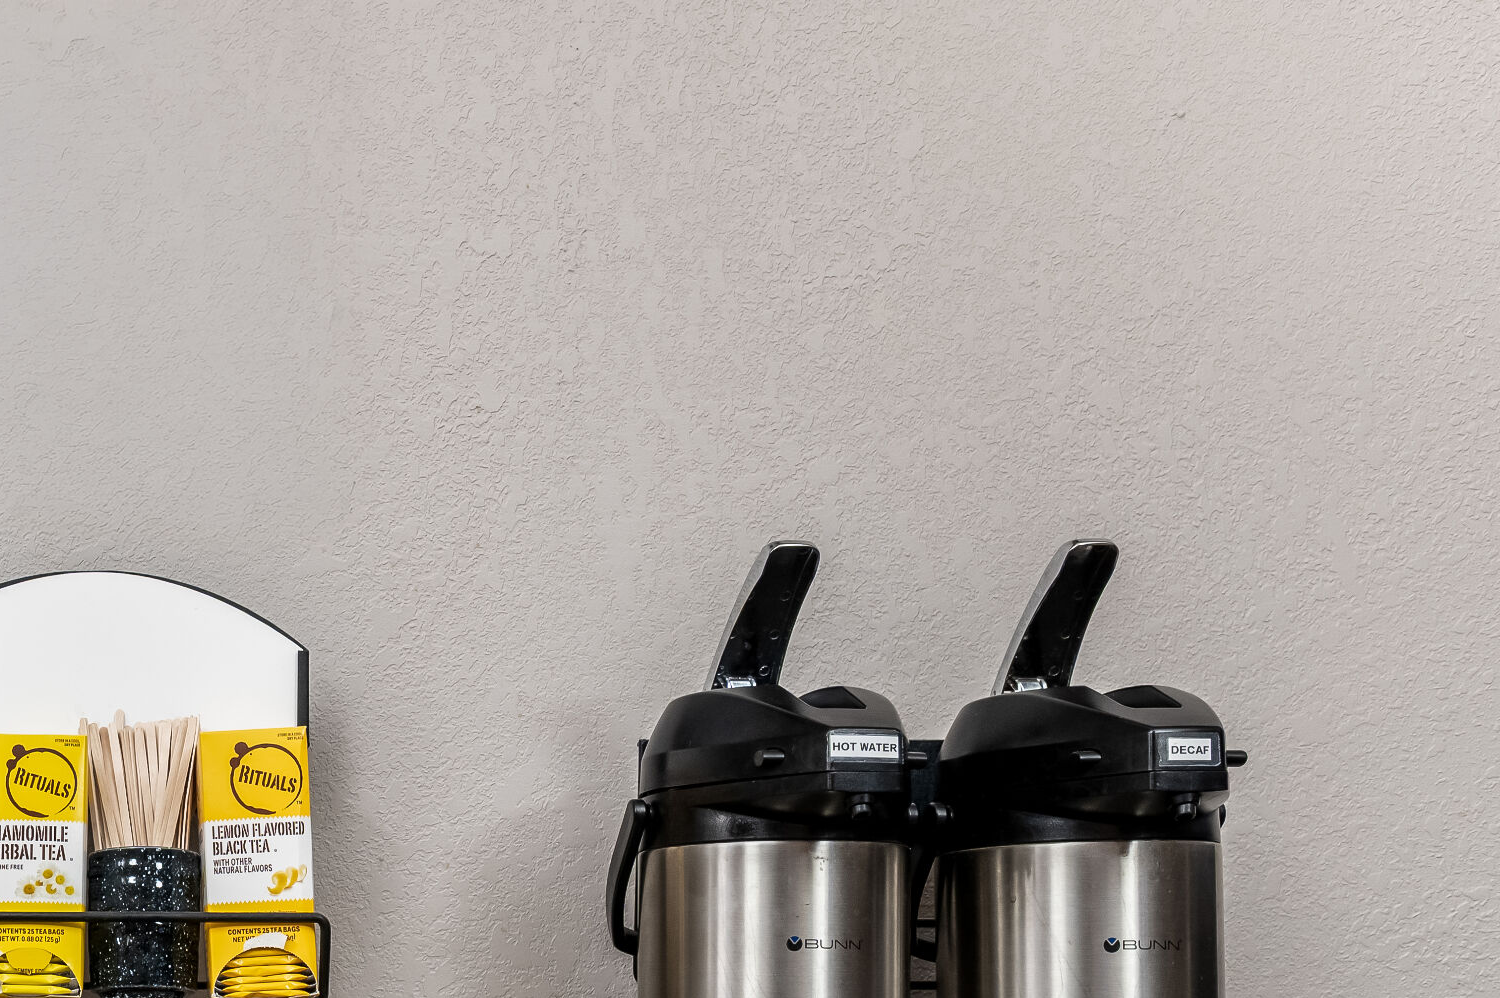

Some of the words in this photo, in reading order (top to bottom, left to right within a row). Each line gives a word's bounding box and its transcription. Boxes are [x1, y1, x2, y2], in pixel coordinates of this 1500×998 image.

[832, 742, 857, 751] HOT
[860, 743, 897, 752] WATER
[1171, 746, 1209, 754] DECAF
[14, 767, 72, 798] RITUALS
[238, 765, 298, 793] RITUALS
[212, 824, 250, 839] LEMON
[252, 821, 305, 838] FLAVORED
[40, 844, 66, 861] TEA
[213, 840, 247, 856] BLACK
[249, 839, 270, 853] TEA
[213, 859, 230, 867] WITH
[231, 857, 252, 866] OTHER
[213, 865, 243, 875] NATURAL
[244, 864, 273, 873] FLAVORS
[227, 927, 261, 936] CONTENTS
[54, 936, 61, 944] g)
[805, 938, 861, 950] BUNN
[1123, 939, 1180, 951] BUNN
